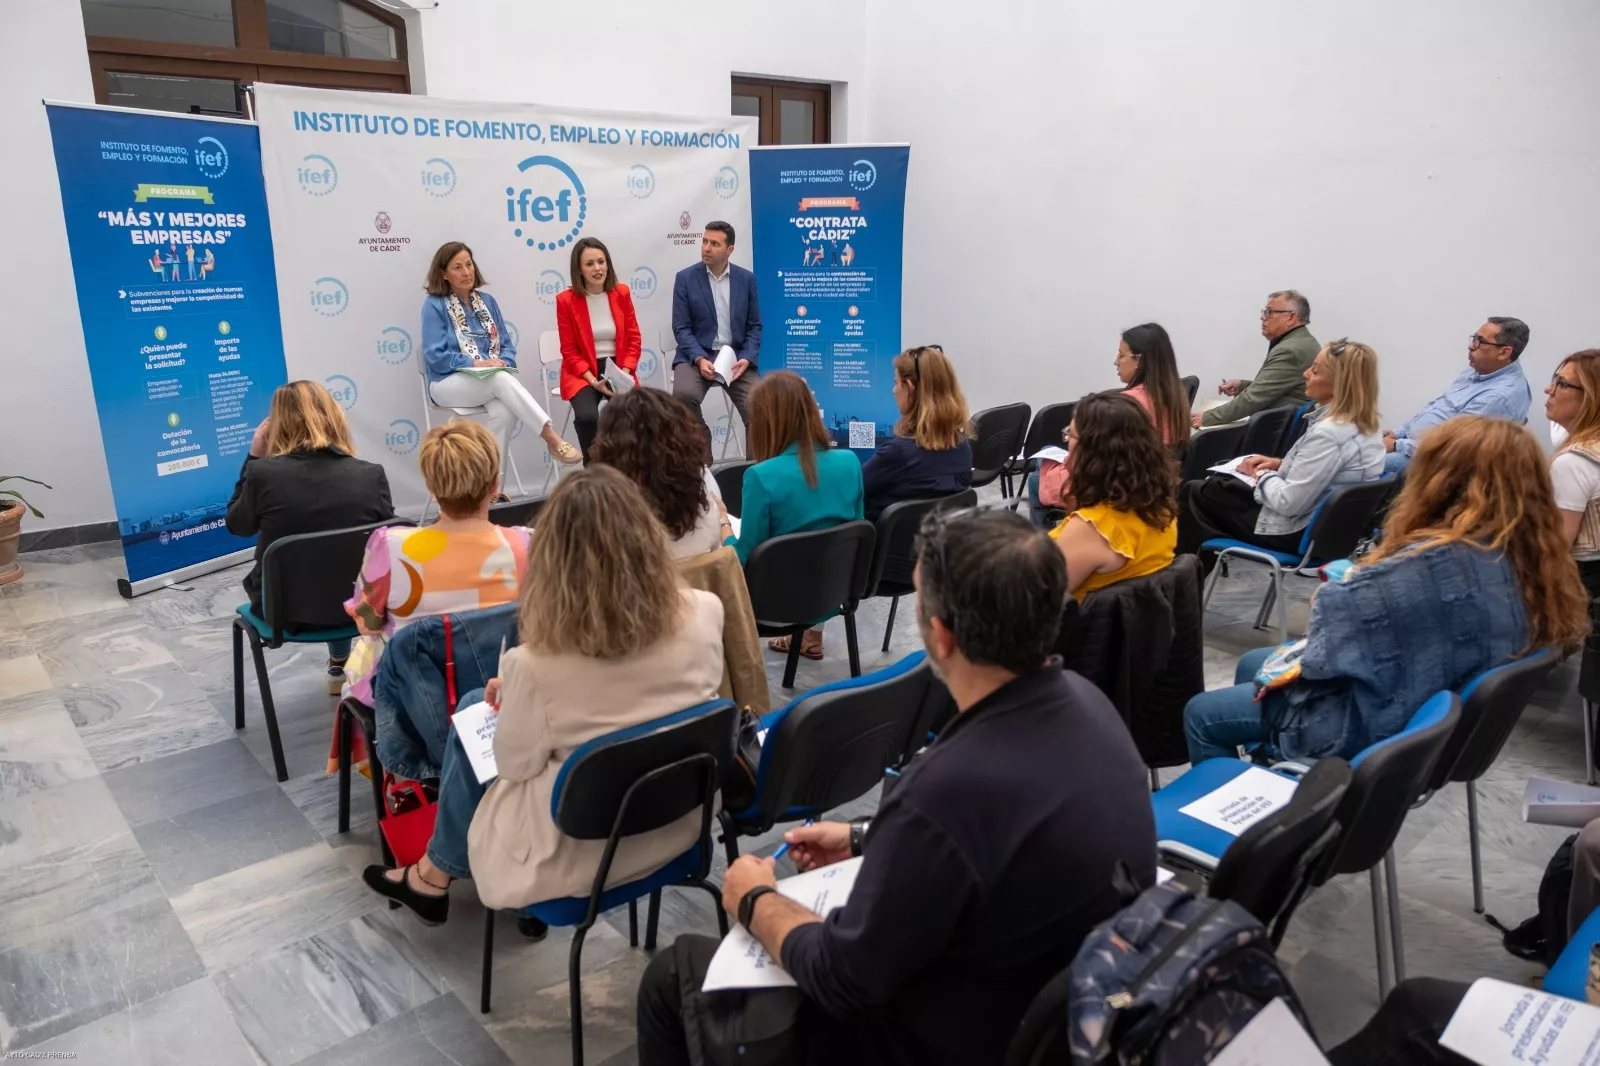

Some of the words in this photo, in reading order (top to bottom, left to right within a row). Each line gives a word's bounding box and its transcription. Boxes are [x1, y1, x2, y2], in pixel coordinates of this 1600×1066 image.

[294, 111, 408, 135] INSTITUTO
[414, 118, 440, 136] DE
[445, 120, 546, 144] FOMENTO,
[550, 125, 620, 144] EMPLEO
[625, 129, 636, 144] Y
[642, 129, 740, 149] FORMACIÓN
[100, 141, 140, 151] INSTITUTO
[152, 145, 188, 156] FOMENTO,
[102, 152, 133, 161] EMPLEO
[143, 154, 187, 164] FORMACIÓN
[195, 149, 222, 166] ifef
[298, 168, 331, 184] ifef
[422, 171, 451, 186] ifef
[628, 176, 650, 190] ifef
[715, 176, 735, 190] ifef
[849, 170, 871, 182] ifef
[151, 188, 196, 196] PROGRAMA
[506, 187, 571, 222] ifef
[154, 212, 168, 227] Y
[170, 213, 246, 228] MEJORES
[536, 281, 560, 295] ifef
[630, 275, 653, 290] ifef
[310, 291, 342, 305] ifef
[140, 345, 165, 354] ¿Quién
[166, 342, 187, 351] puede
[377, 340, 406, 354] ifef
[149, 352, 181, 362] presentar
[154, 359, 185, 368] solicitud?
[219, 353, 240, 362] ayudas
[162, 428, 192, 440] Dotación
[386, 430, 414, 445] ifef
[158, 443, 200, 457] convocatoria
[168, 459, 194, 471] 200.000
[172, 523, 209, 540] Ayuntamiento
[218, 518, 226, 527] Cá
[476, 723, 496, 736] pres
